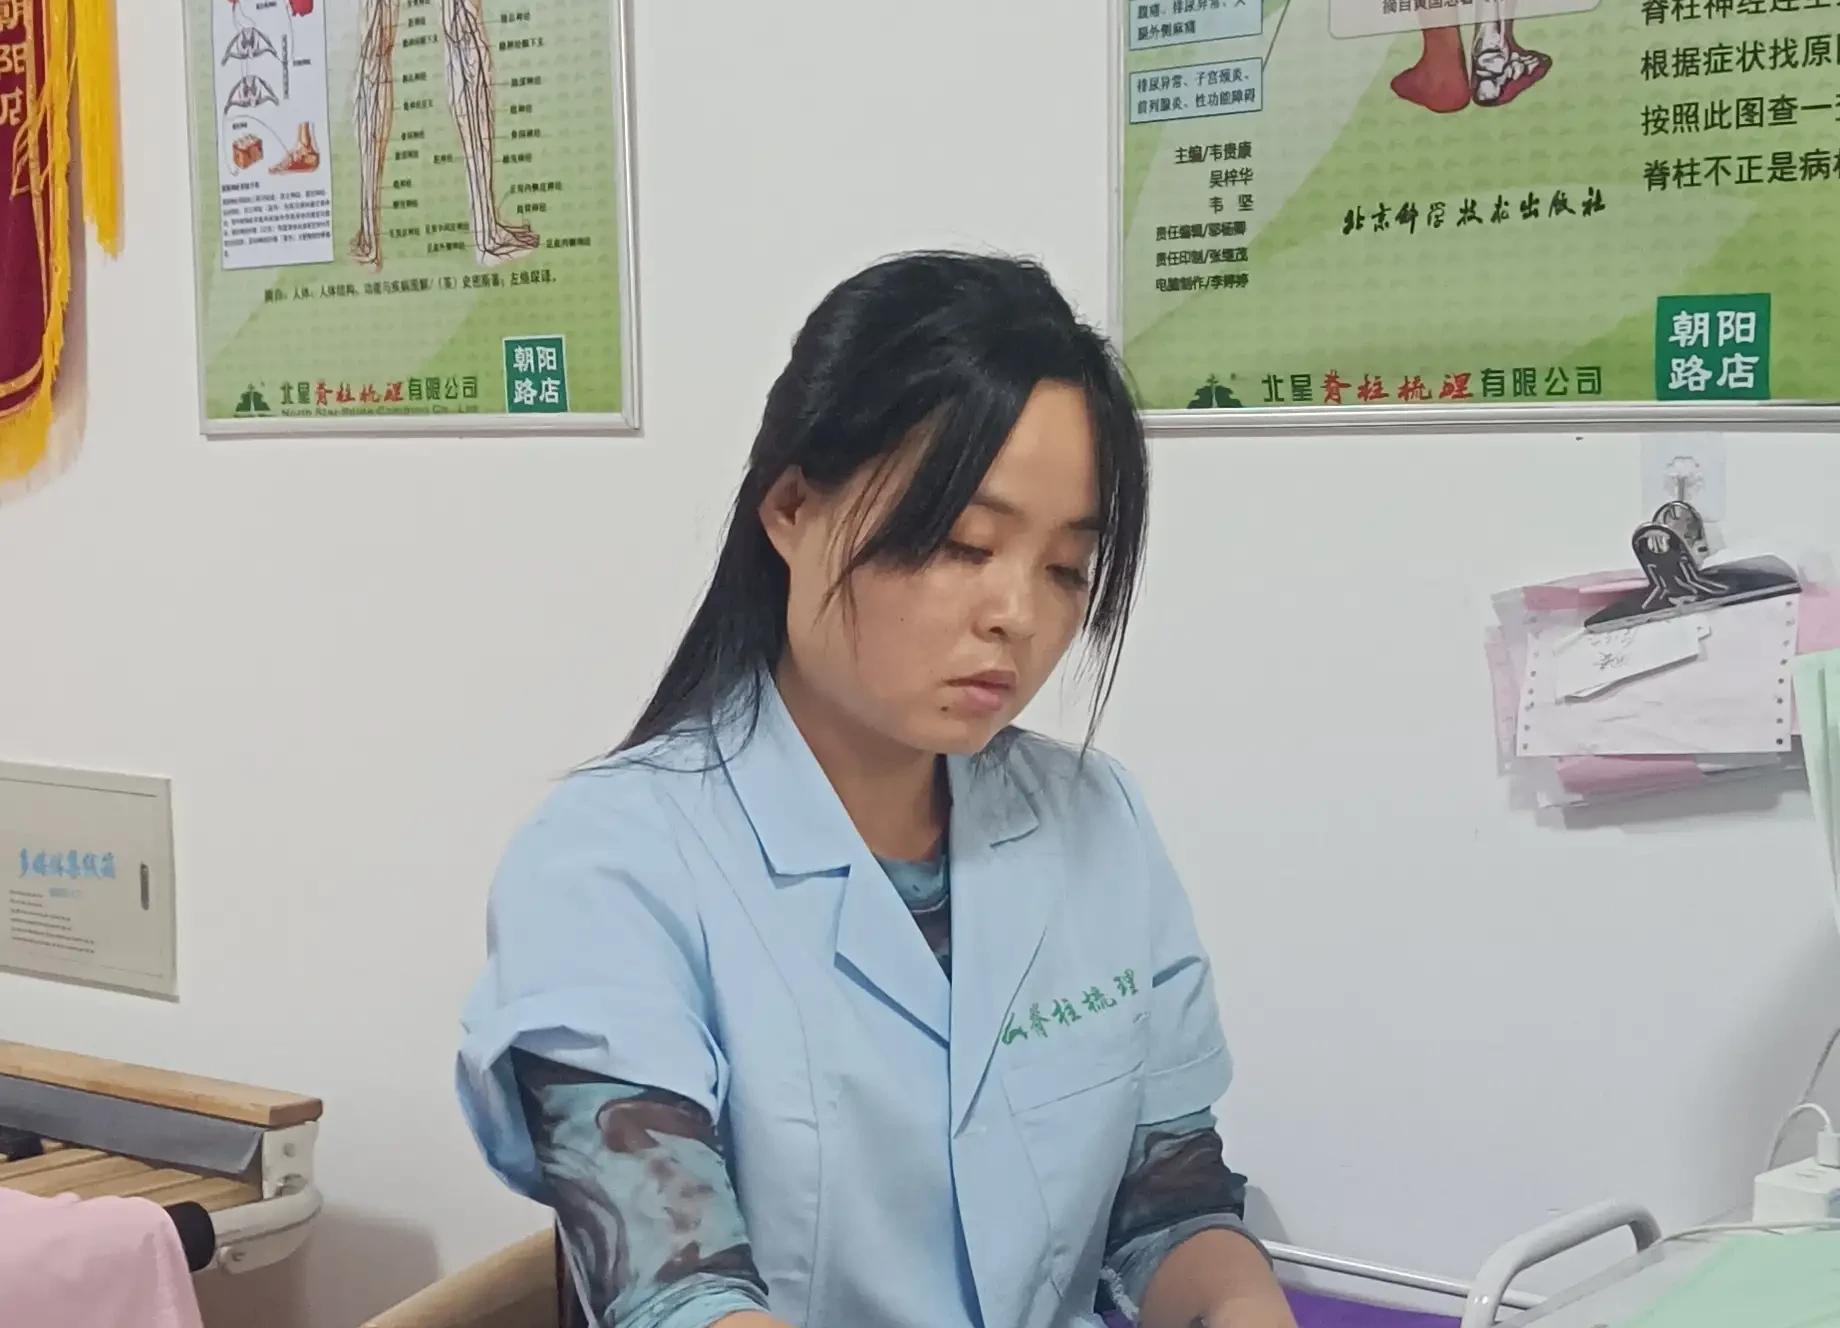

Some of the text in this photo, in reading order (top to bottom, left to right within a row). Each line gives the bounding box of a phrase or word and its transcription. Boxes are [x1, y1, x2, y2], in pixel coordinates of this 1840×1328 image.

[1640, 32, 1840, 81] 根据症状找原
[1640, 93, 1840, 136] 按照此图查一
[1342, 186, 1606, 235] 北京科学技术出版社
[1668, 310, 1757, 348] 朝阳
[513, 345, 557, 373] 朝阳
[1667, 353, 1759, 391] 路店
[514, 378, 561, 406] 路店
